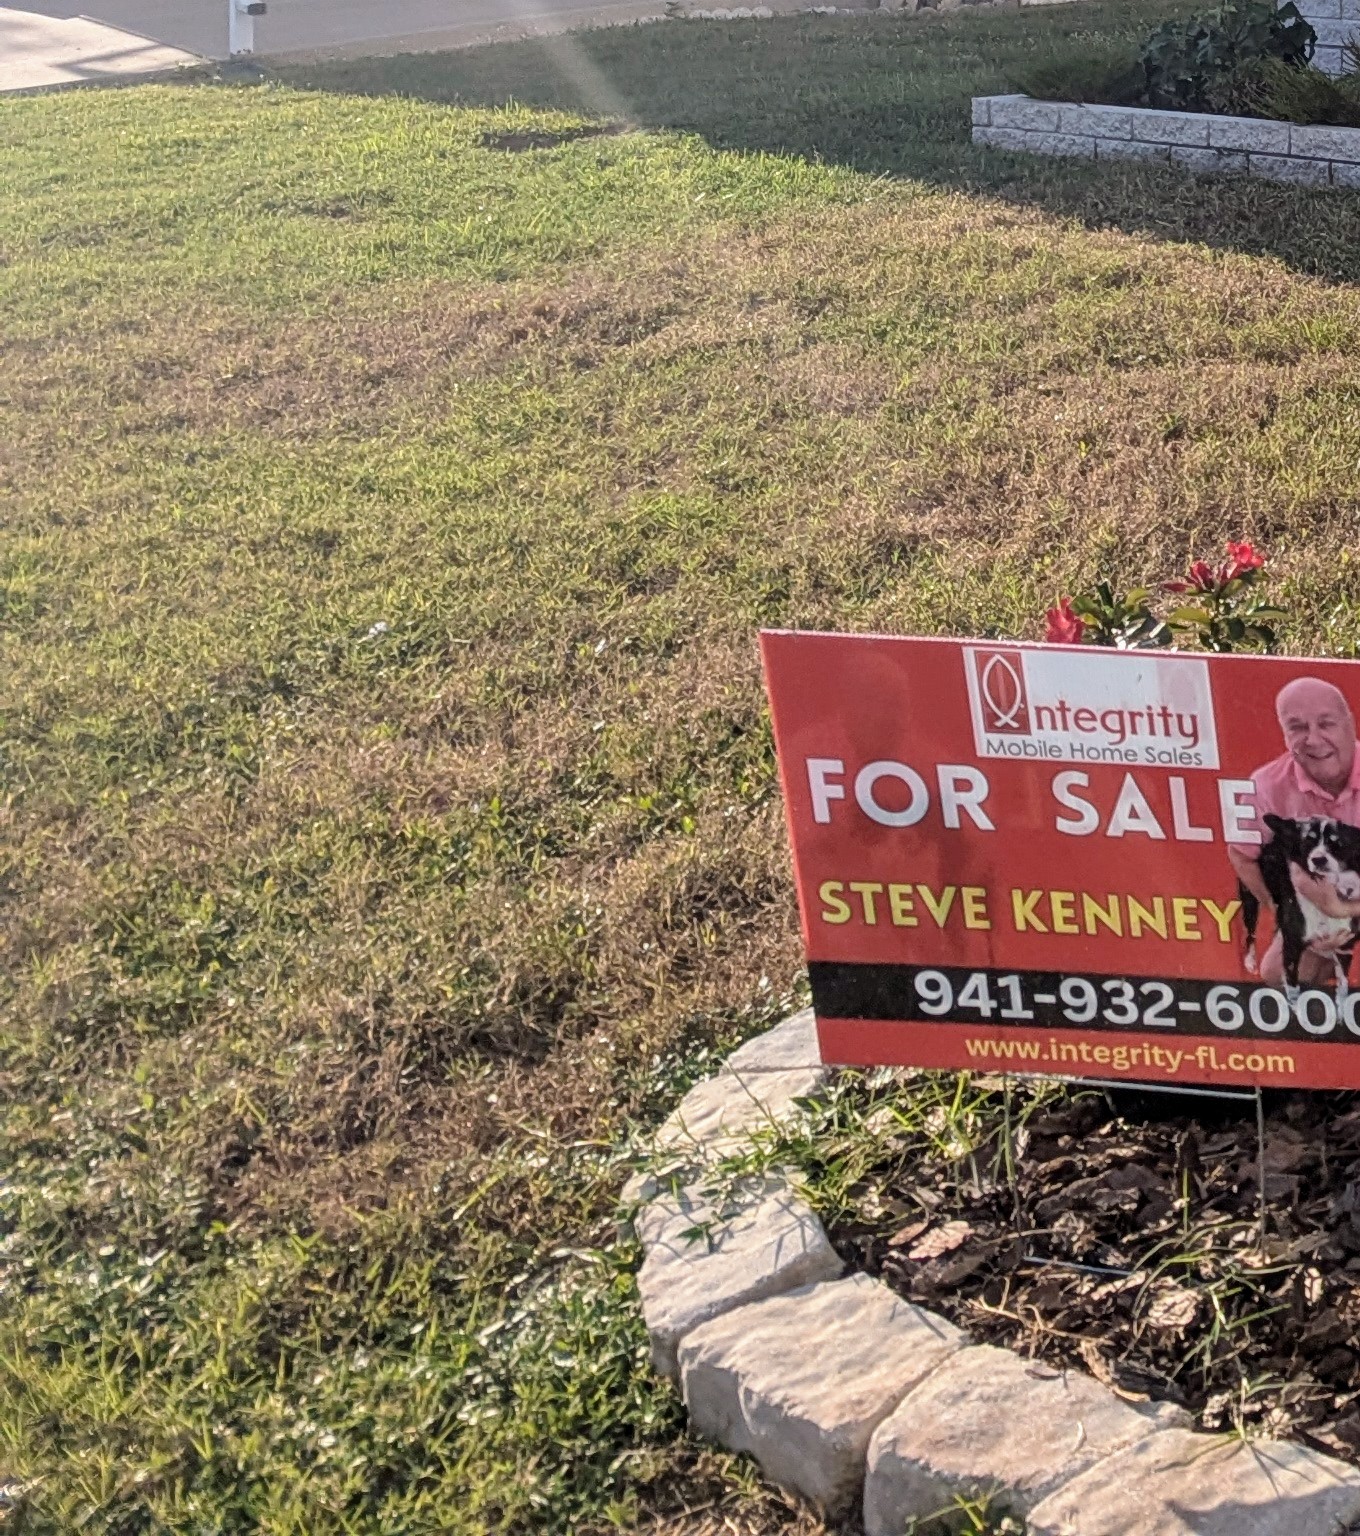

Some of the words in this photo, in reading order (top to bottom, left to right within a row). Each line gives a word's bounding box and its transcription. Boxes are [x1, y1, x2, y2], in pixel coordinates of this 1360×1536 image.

[986, 738, 1062, 758] Mobile
[1071, 743, 1138, 762] Home
[1145, 747, 1202, 765] Sales
[806, 758, 996, 831] FOR
[1051, 770, 1263, 844] SALE
[819, 880, 991, 930] STEVE
[1011, 888, 1242, 942] KENNEY
[965, 1036, 1295, 1074] www.integrity-fl.com
